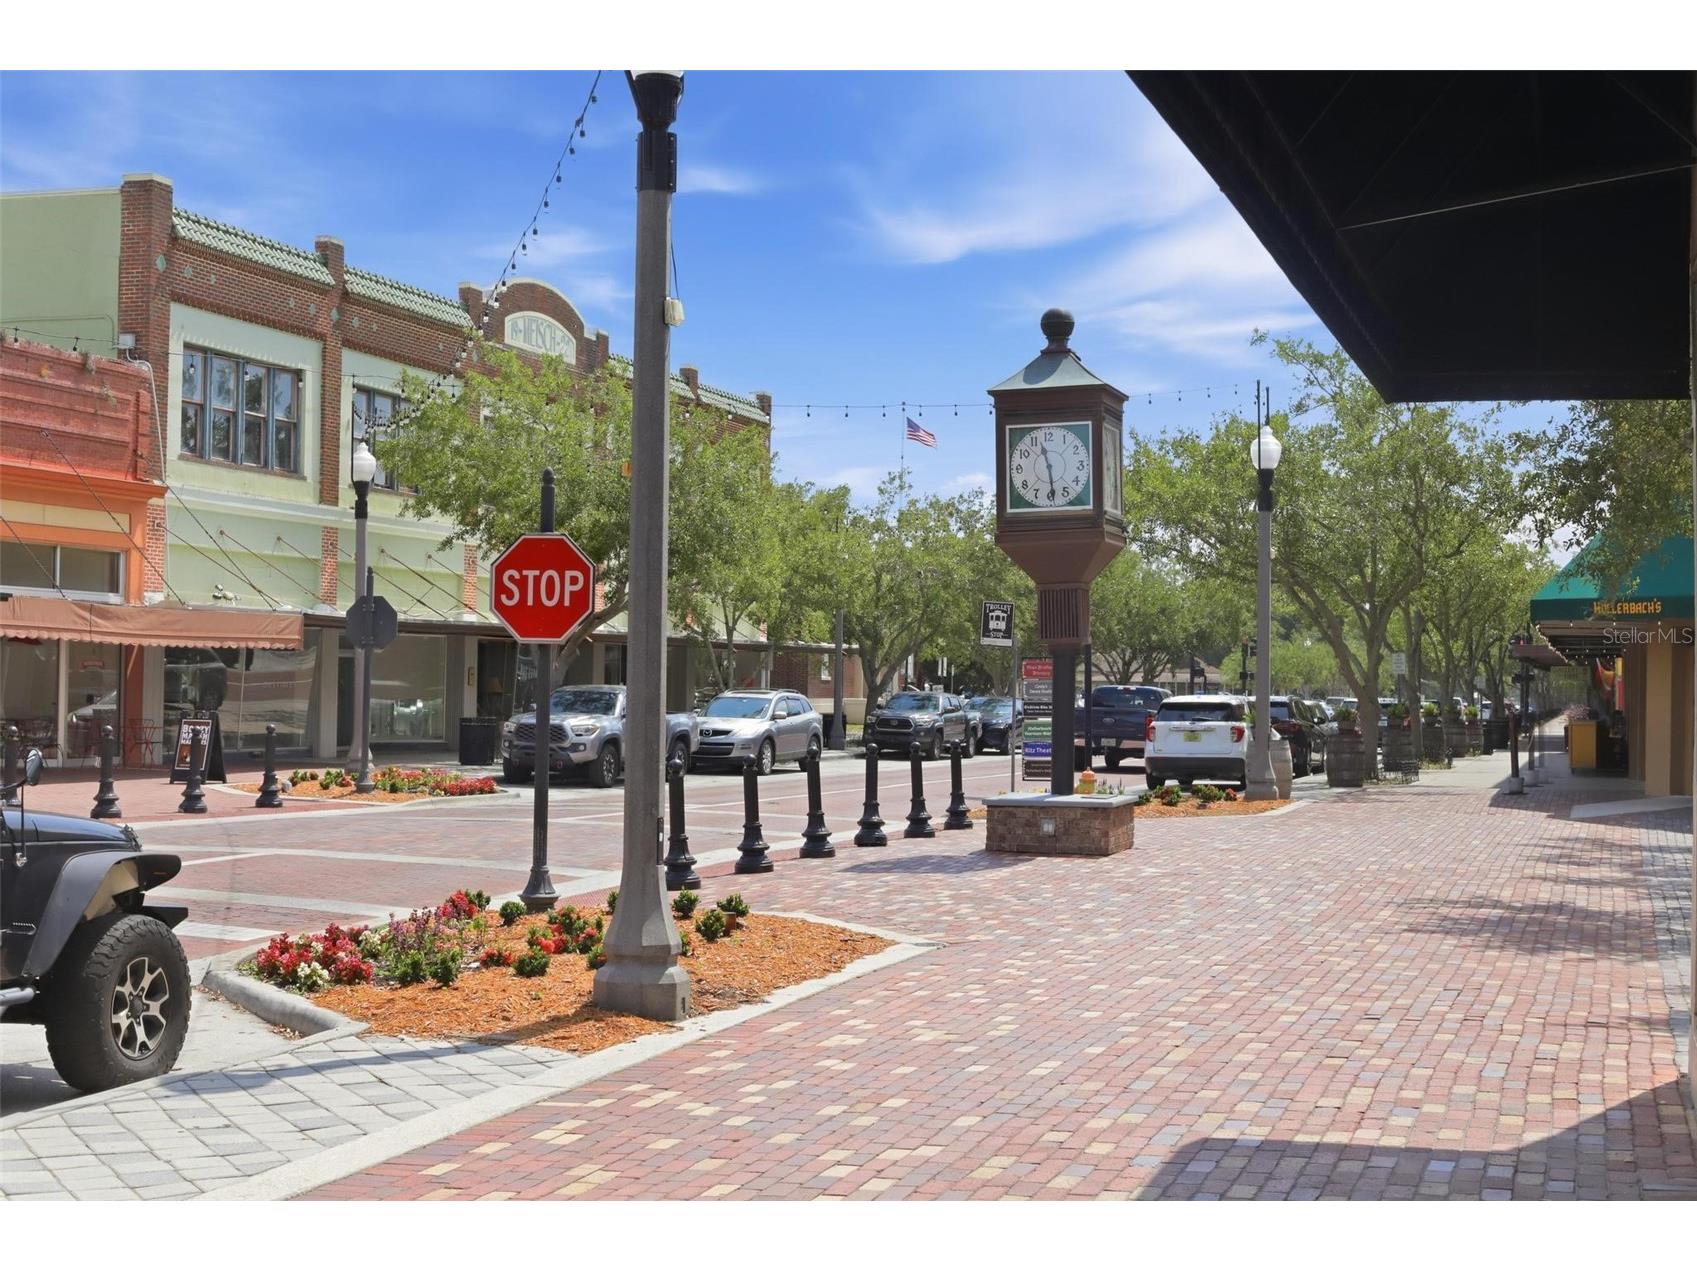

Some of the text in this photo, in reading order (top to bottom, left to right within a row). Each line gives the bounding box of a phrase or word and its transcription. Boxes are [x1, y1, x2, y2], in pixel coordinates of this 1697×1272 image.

[1031, 436, 1038, 447] 11
[1044, 432, 1054, 442] 12
[1020, 448, 1030, 459] 10
[1072, 445, 1079, 455] 2
[1015, 464, 1023, 474] 9
[1076, 460, 1085, 471] 3
[1021, 480, 1028, 490] 8
[1072, 475, 1080, 486] 4
[1033, 488, 1039, 499] 7
[1061, 486, 1069, 498] 5
[500, 569, 584, 607] STOP
[985, 603, 1011, 614] TROLLEY
